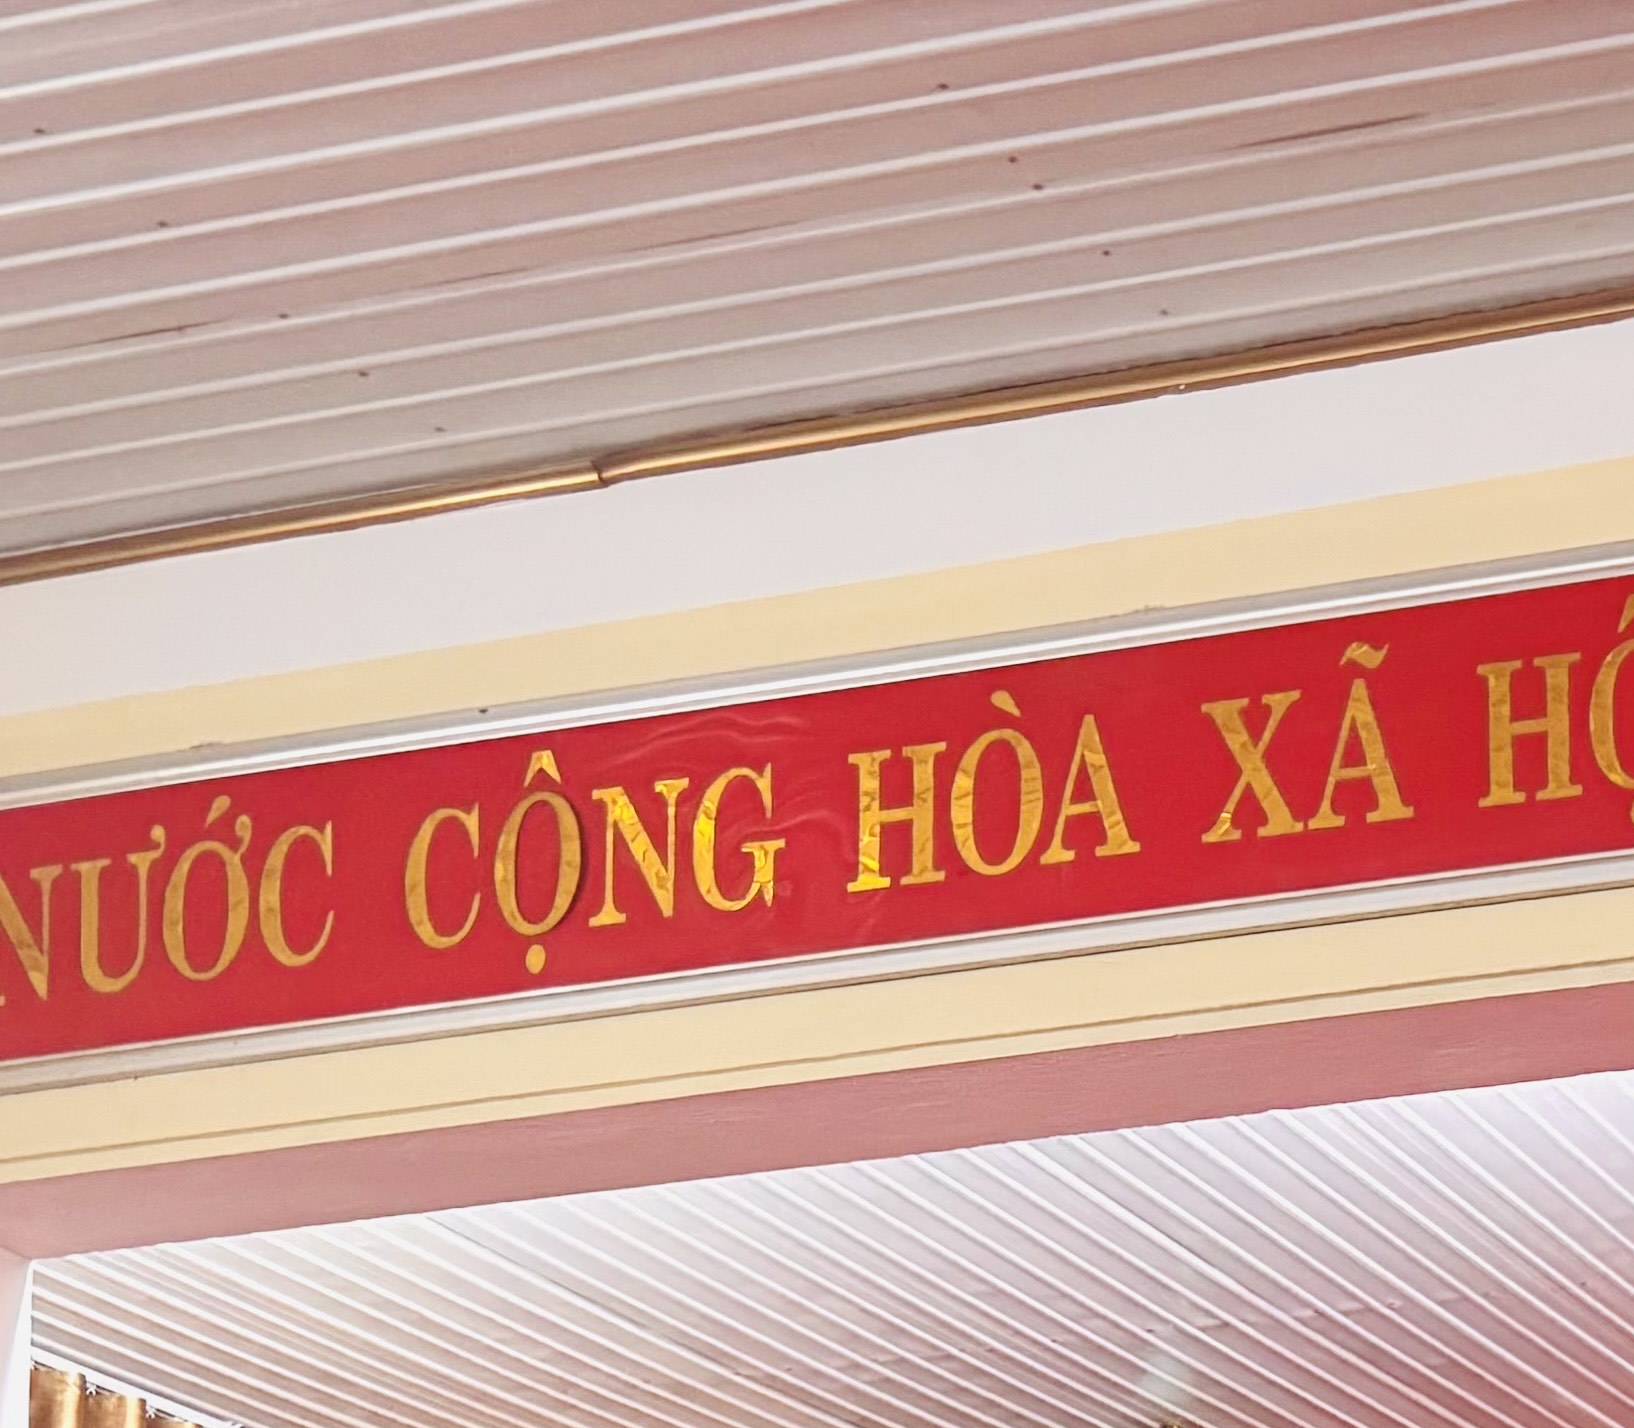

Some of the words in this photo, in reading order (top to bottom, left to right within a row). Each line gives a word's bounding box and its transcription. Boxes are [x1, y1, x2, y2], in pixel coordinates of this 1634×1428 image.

[0, 795, 335, 1006] NƯỚC
[404, 750, 785, 974] CỘNG
[847, 691, 1140, 893] HÒA
[1200, 641, 1413, 844] XÃ
